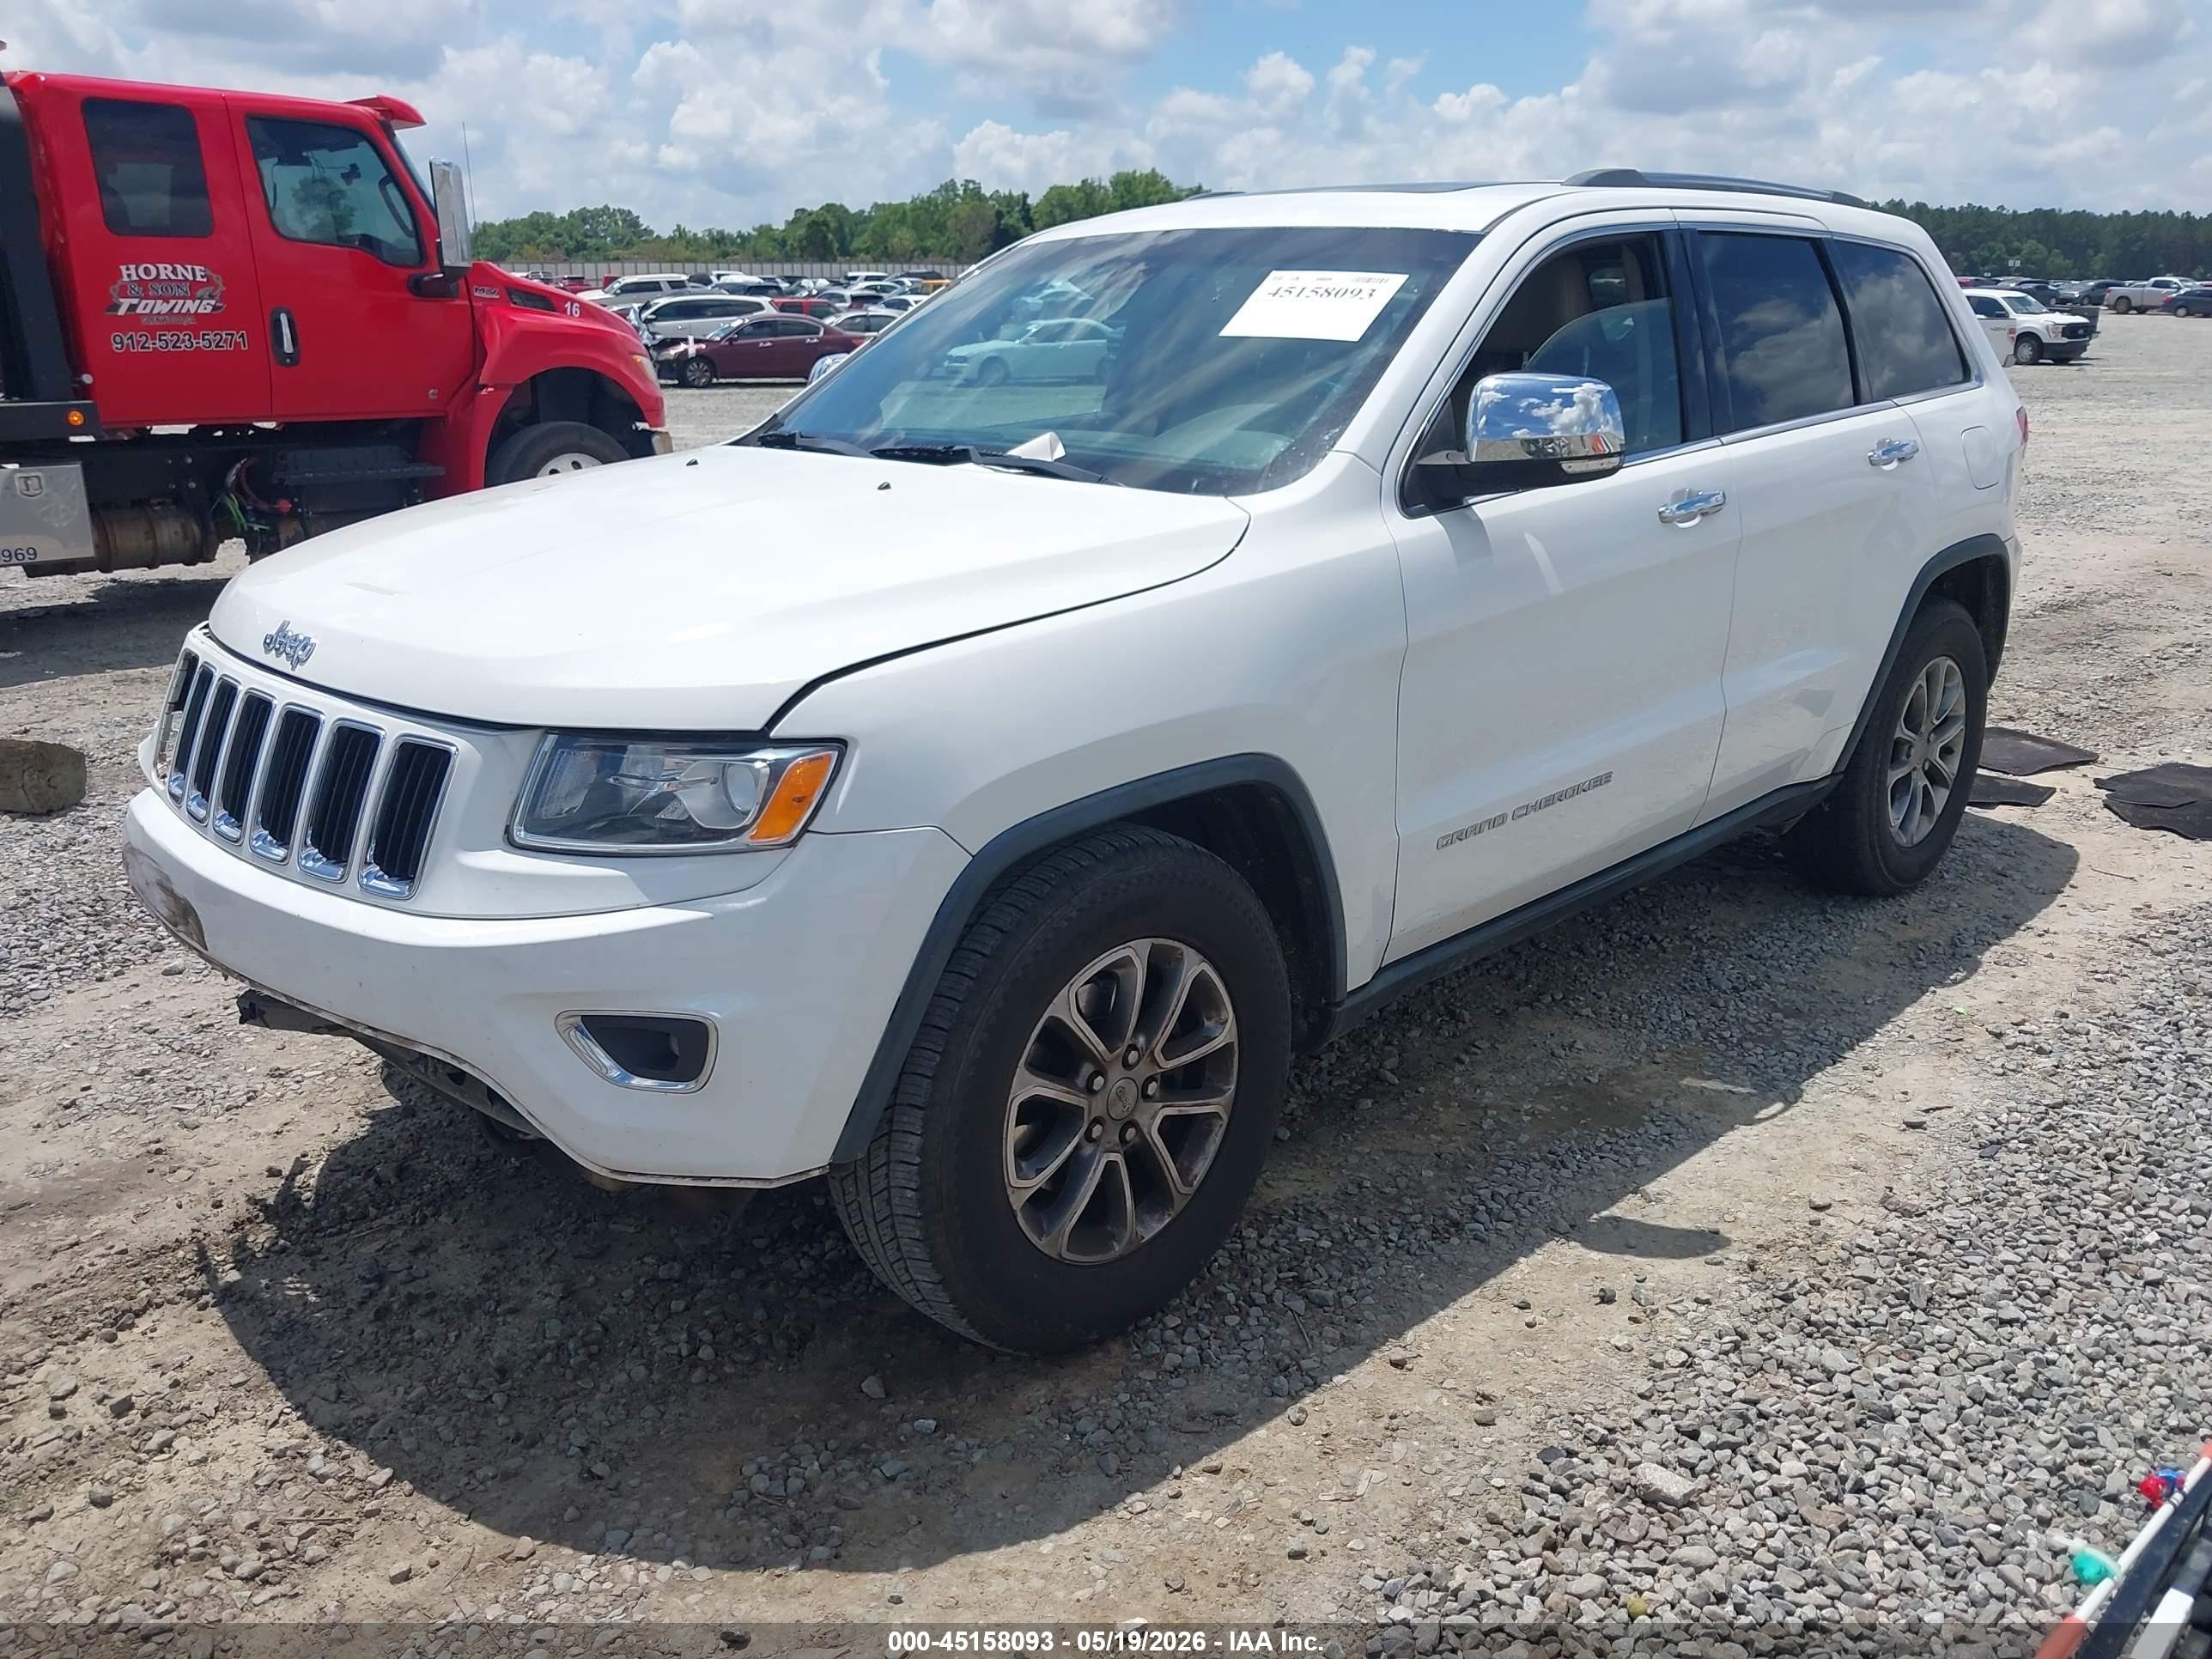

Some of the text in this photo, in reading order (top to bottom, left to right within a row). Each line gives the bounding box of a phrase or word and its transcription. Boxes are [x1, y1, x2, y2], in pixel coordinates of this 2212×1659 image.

[119, 264, 208, 282] HORNE
[127, 282, 191, 297] & SON
[1267, 286, 1377, 301] 45158093
[117, 298, 216, 316] TOWING
[564, 301, 581, 318] 16
[111, 331, 249, 353] 912-523-5271
[1, 547, 38, 563] 969
[262, 619, 317, 672] Jeep
[1436, 771, 1614, 851] GRAND CHEROKEE
